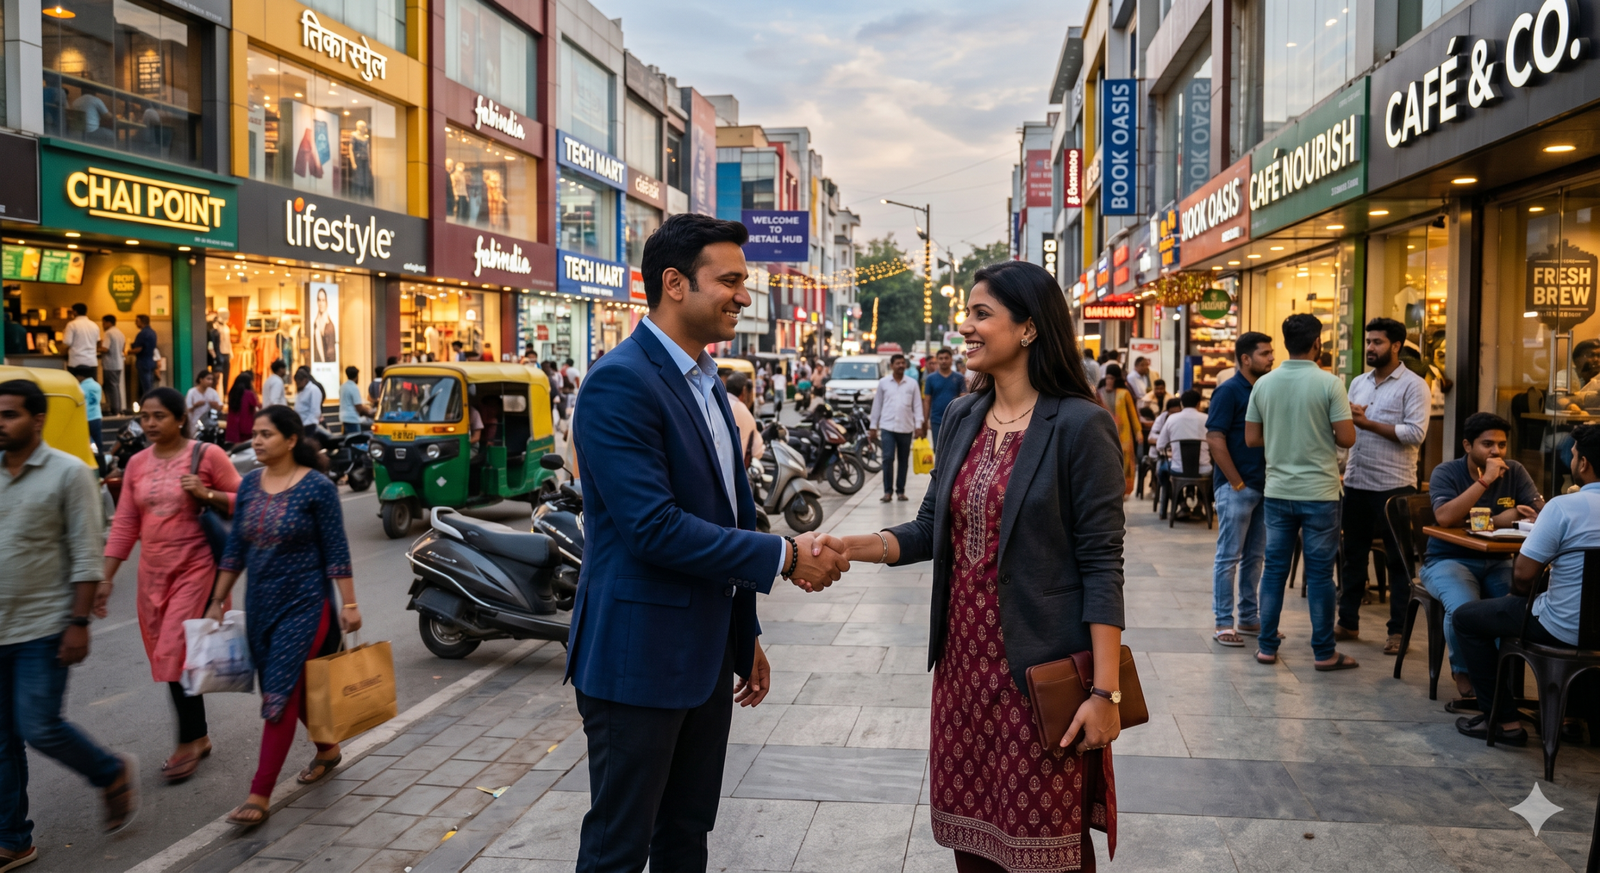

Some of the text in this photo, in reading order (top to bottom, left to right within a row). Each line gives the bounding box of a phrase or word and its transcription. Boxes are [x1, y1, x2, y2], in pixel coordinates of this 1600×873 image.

[1385, 0, 1581, 149] CAFÉ & CO.
[475, 94, 526, 141] fabindia
[564, 136, 625, 184] TECH MART
[1111, 84, 1130, 209] BOOK OASIS
[1249, 113, 1355, 211] CAFÉ NOURISH
[66, 171, 226, 228] CHAI POINT
[752, 216, 800, 225] WELCOME
[1208, 176, 1240, 228] OASIS
[748, 234, 803, 244] RETAIL HUB
[769, 225, 783, 234] TO
[474, 234, 532, 278] fabindia
[563, 255, 595, 283] TECH
[595, 262, 625, 288] MART
[1533, 266, 1592, 286] FRESH
[1533, 286, 1591, 306] BREW
